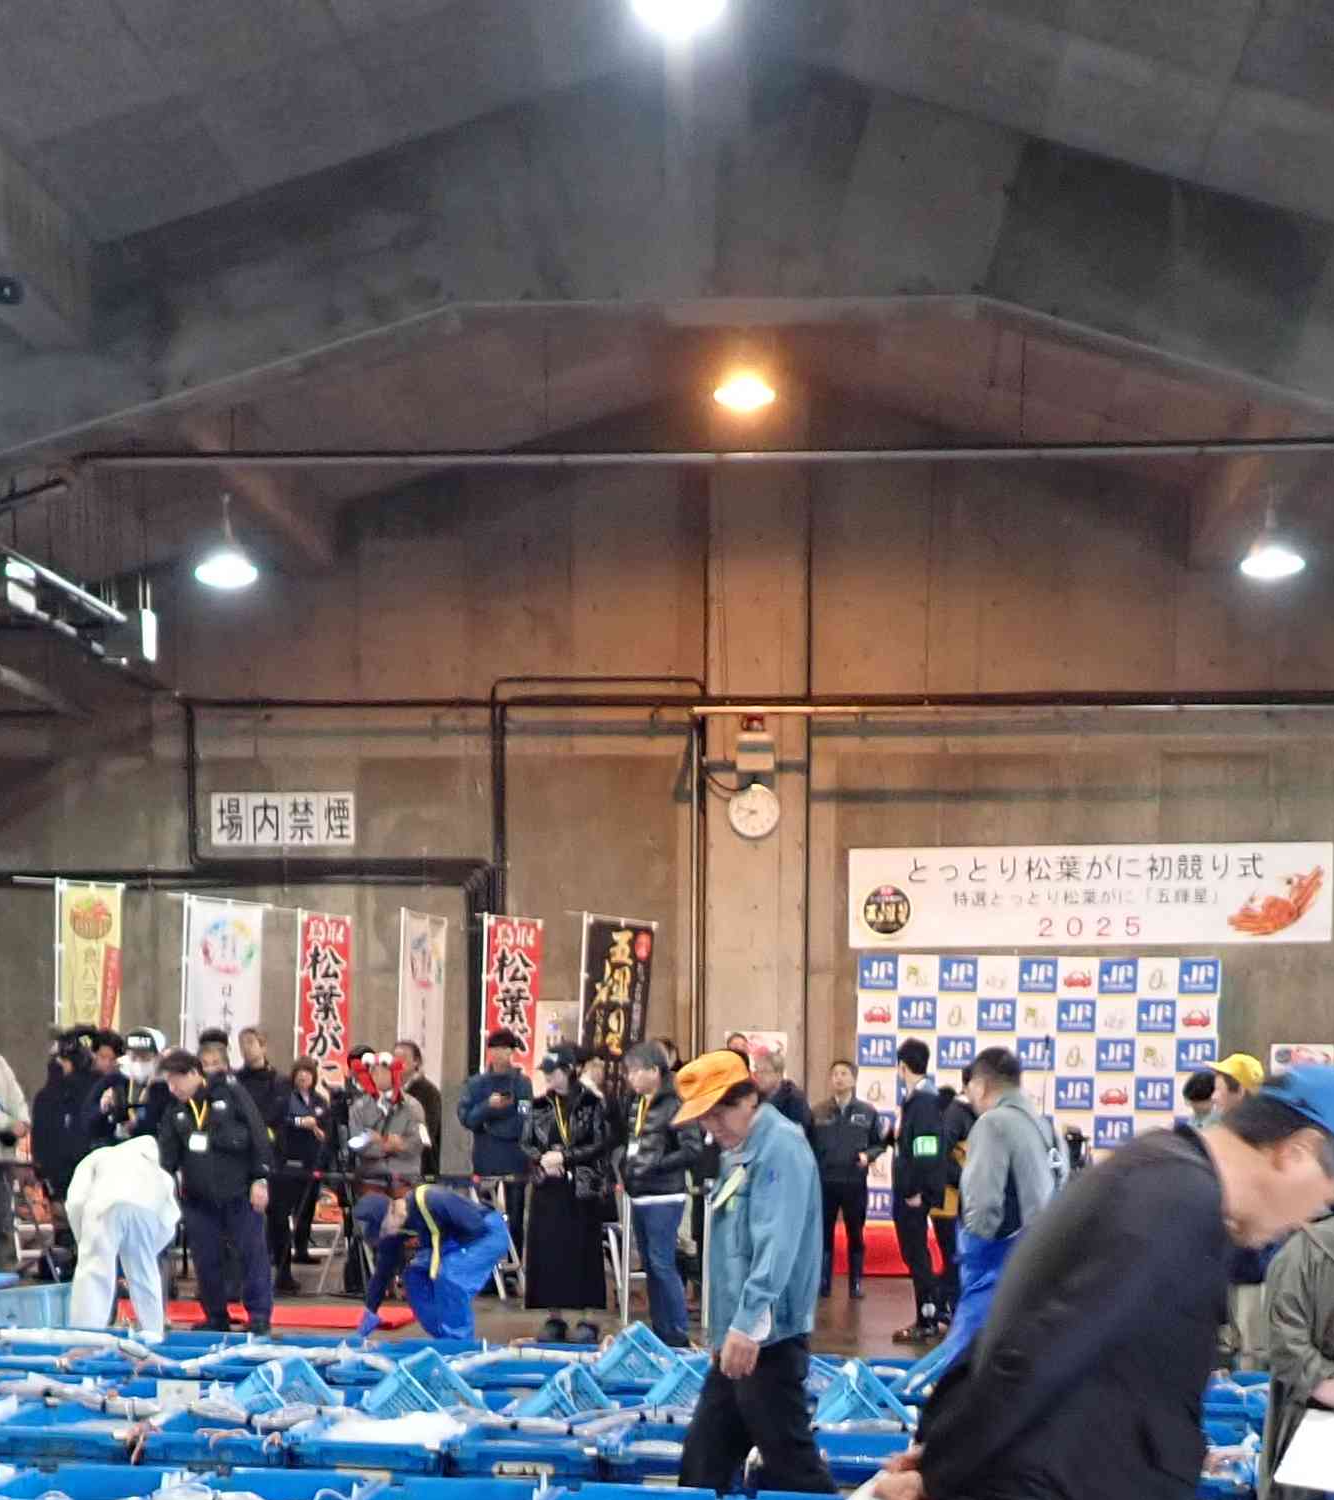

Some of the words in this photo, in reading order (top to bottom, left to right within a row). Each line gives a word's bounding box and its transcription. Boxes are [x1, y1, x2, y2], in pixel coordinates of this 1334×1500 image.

[217, 797, 349, 842] 場内禁煙
[908, 853, 1264, 882] とっとり松葉がに初競り式
[1038, 916, 1140, 937] 2025
